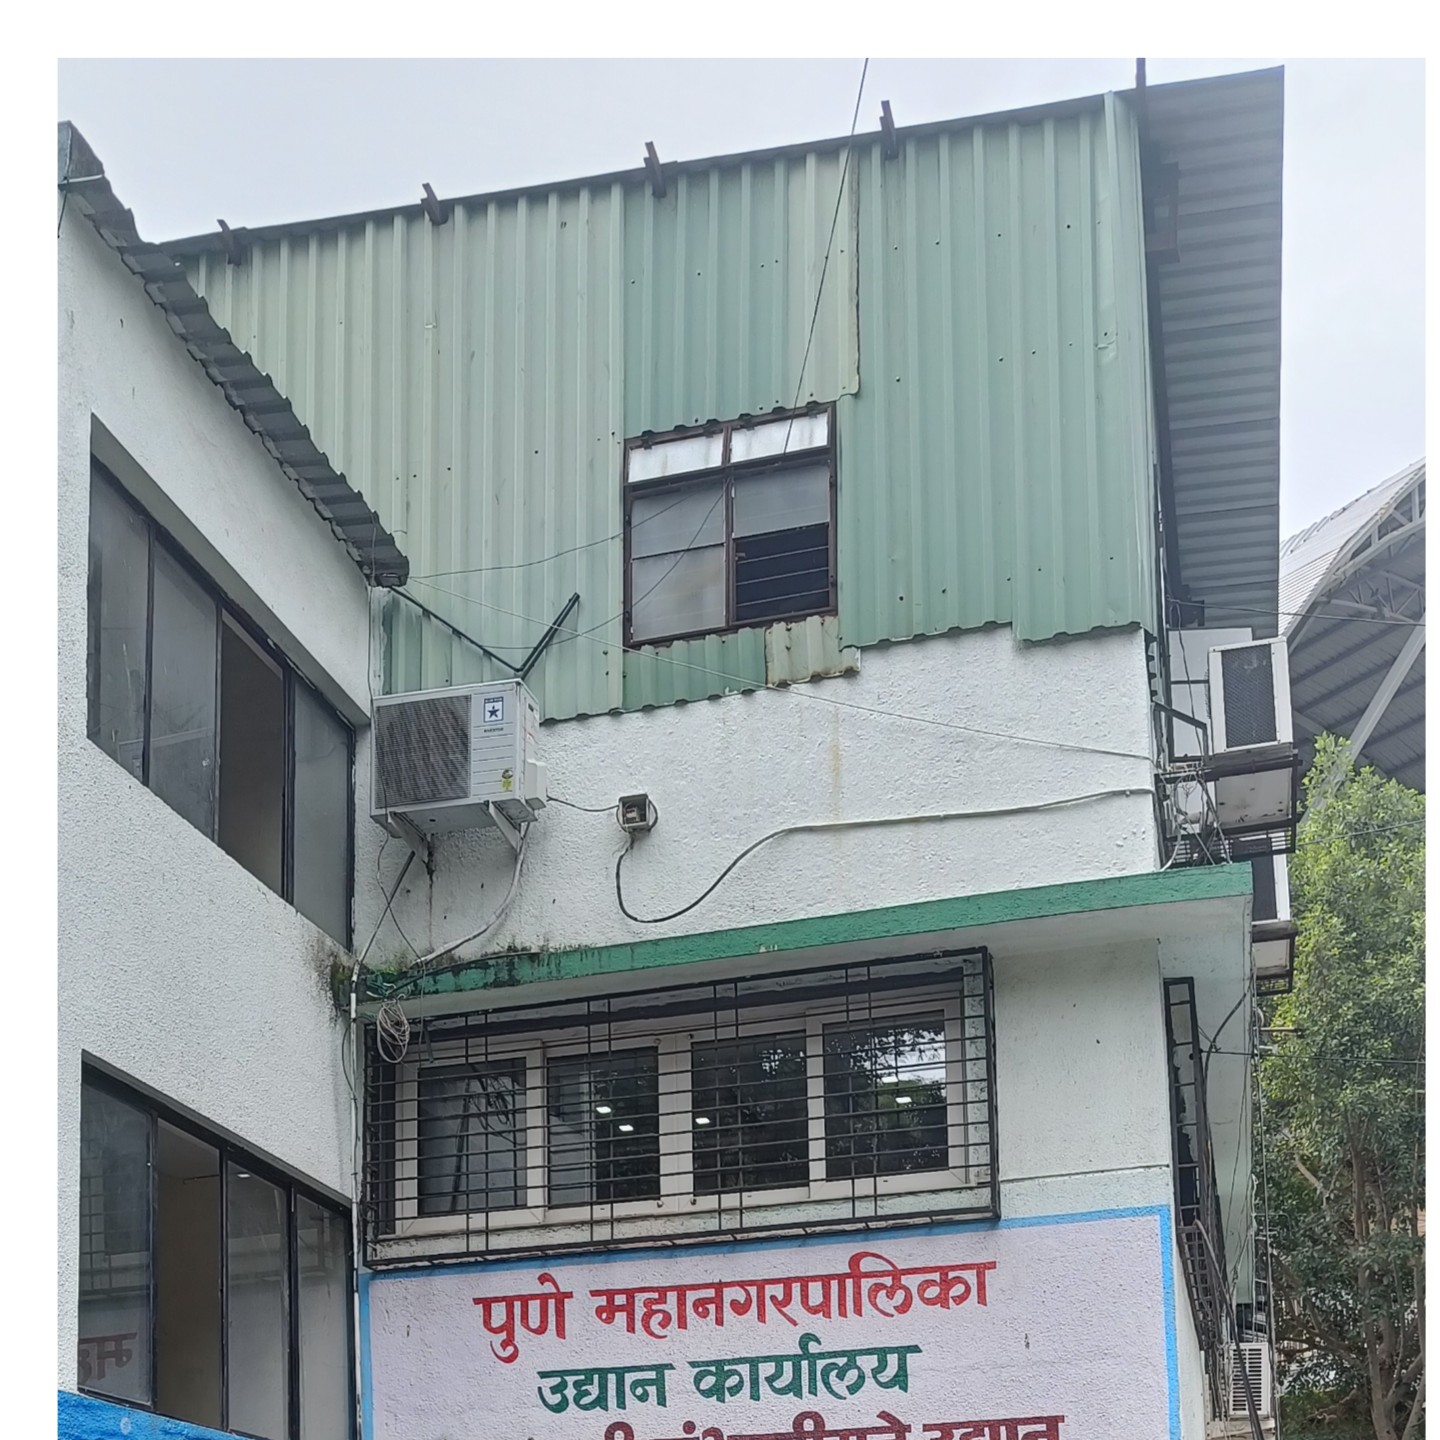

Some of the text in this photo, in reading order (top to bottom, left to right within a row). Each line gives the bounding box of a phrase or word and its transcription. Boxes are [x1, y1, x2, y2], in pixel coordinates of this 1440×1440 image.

[473, 1250, 998, 1364] पुणे महानगरपालिका
[538, 1333, 922, 1414] उद्यान कार्यालय
